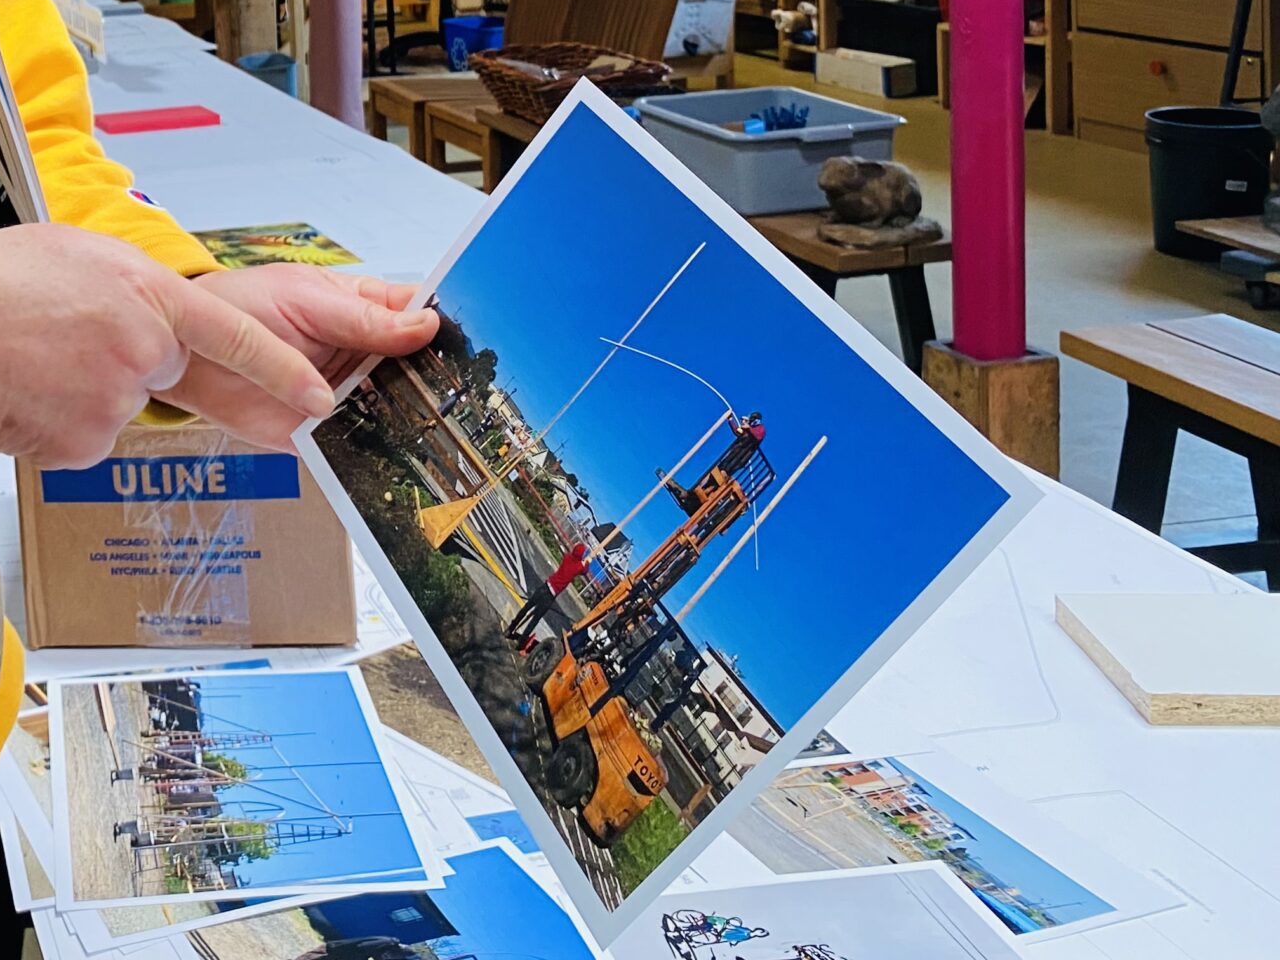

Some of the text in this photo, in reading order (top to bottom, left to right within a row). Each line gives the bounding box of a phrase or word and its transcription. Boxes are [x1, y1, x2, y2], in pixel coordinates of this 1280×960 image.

[112, 462, 226, 495] ULINE
[104, 537, 150, 547] CHICAGO
[89, 552, 108, 562] LOS
[109, 552, 150, 562] ANGELES
